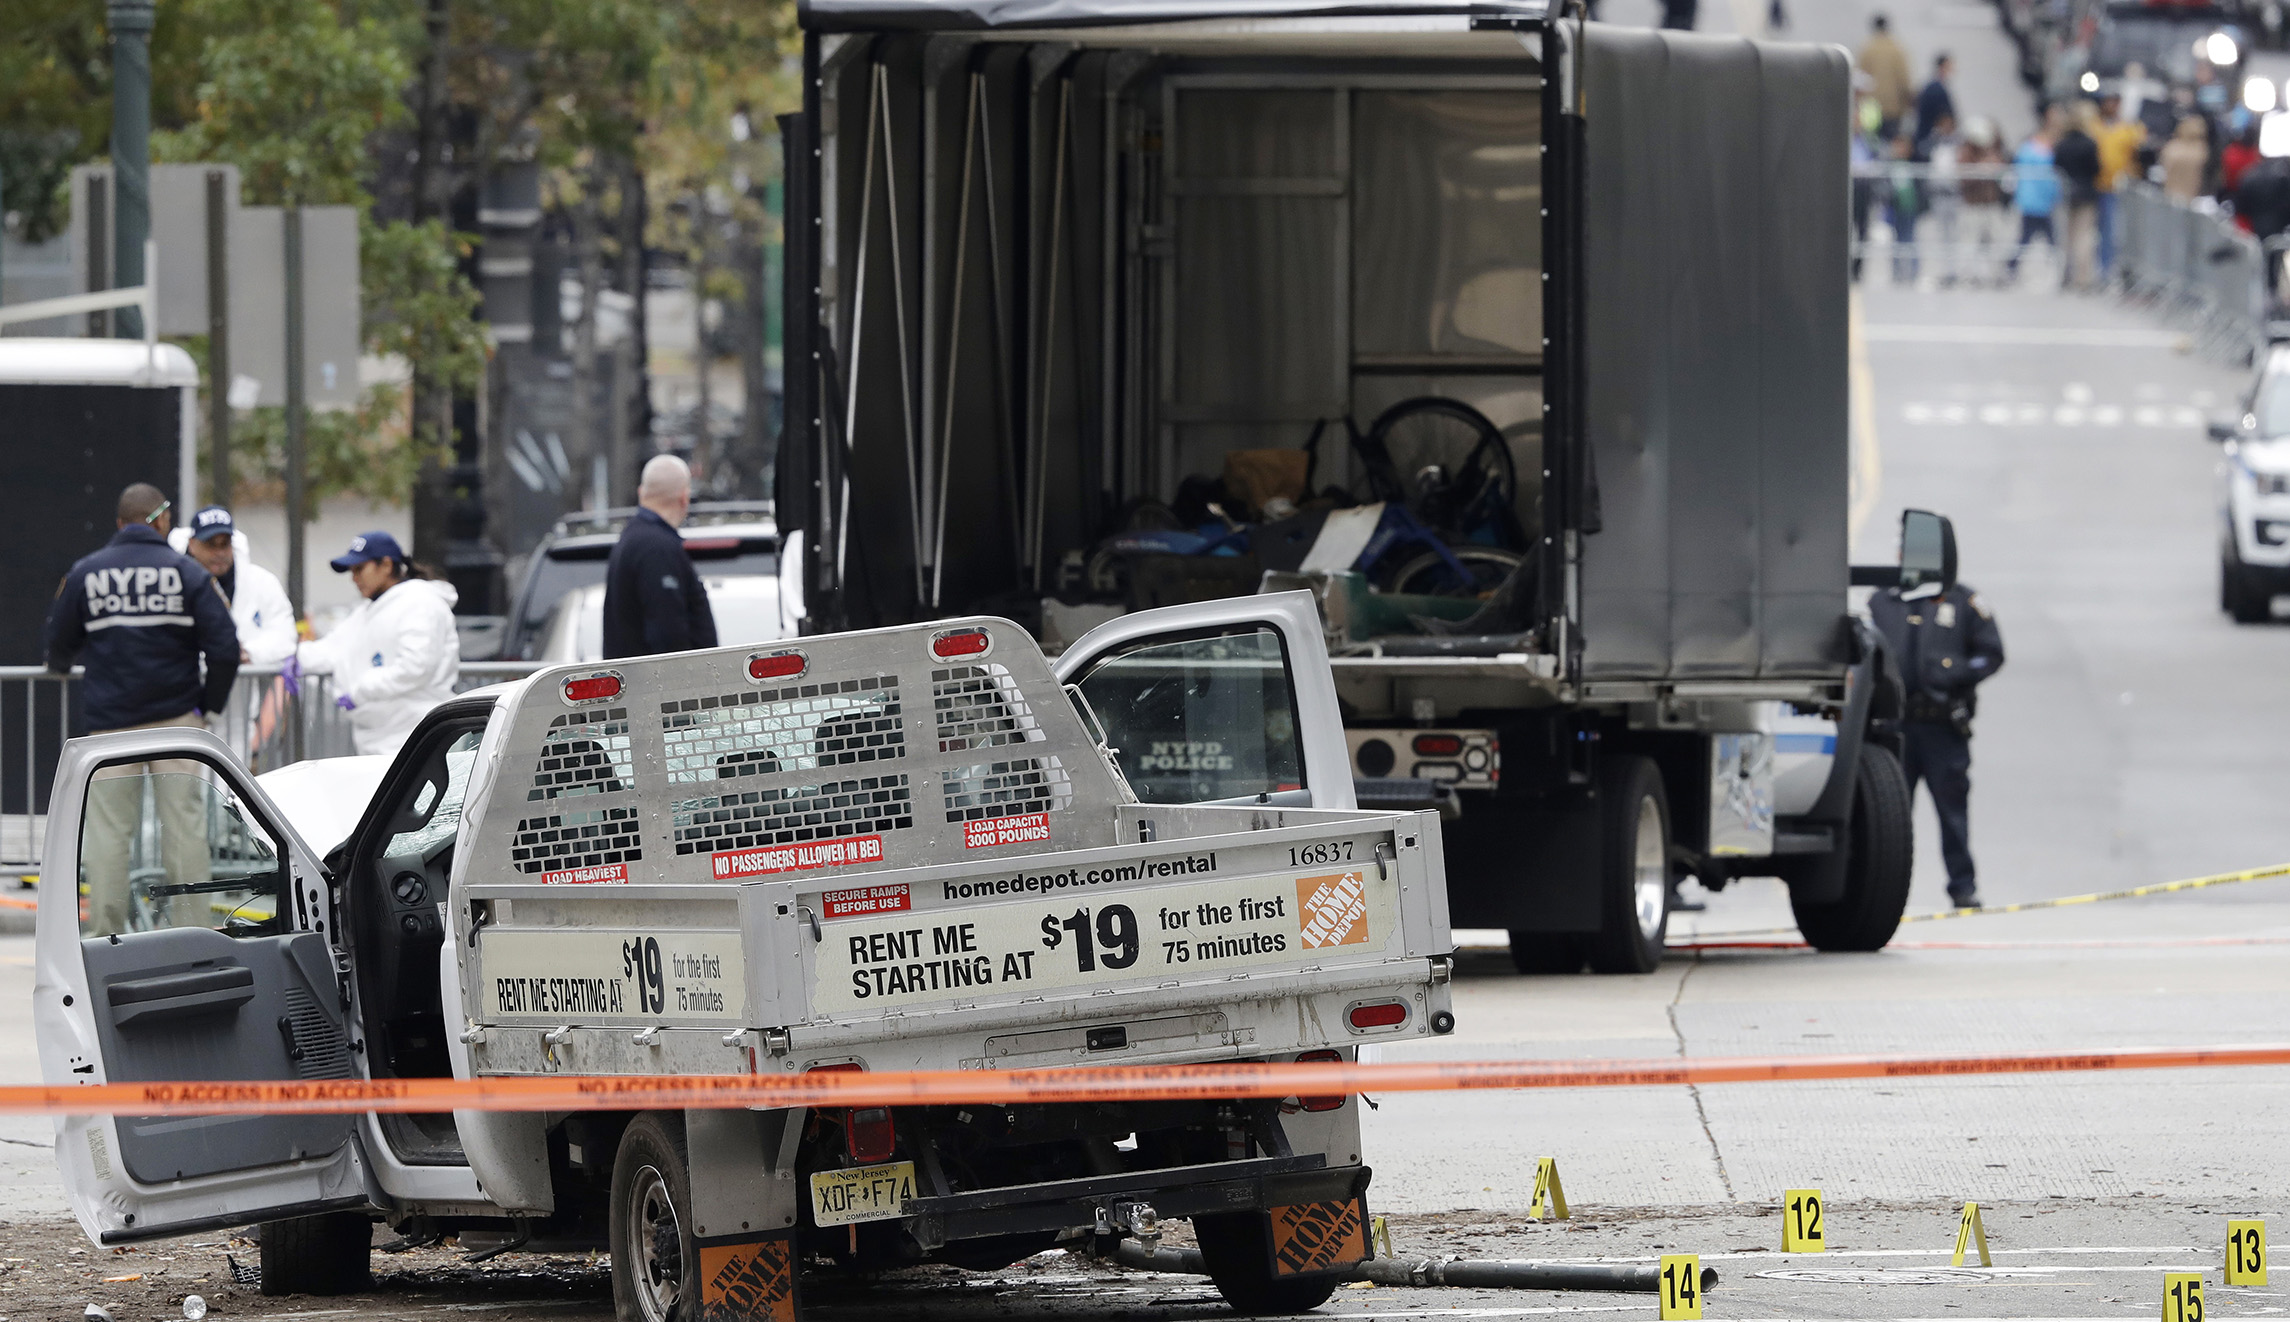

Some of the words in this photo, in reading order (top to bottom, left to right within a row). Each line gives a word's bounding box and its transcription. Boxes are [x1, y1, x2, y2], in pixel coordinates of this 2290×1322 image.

[84, 567, 183, 599] NYPD
[88, 594, 184, 616] POLICE
[1140, 755, 1233, 771] POLICE
[1151, 741, 1222, 756] NYPD
[967, 832, 997, 848] 3000
[998, 825, 1049, 843] POUNDS
[969, 819, 995, 833] LOAD
[996, 814, 1044, 829] CAPACITY
[714, 857, 730, 875] NO
[732, 850, 796, 873] PASSENGERS
[798, 843, 845, 866] ALLOWED
[847, 842, 858, 860] IN
[859, 839, 881, 857] BED
[1288, 841, 1354, 867] 16837
[546, 872, 573, 884] LOAD
[574, 866, 622, 882] HEAVIEST
[943, 852, 1218, 900] homedepot.com/rental
[824, 889, 868, 902] SECURE
[870, 885, 908, 898] RAMPS
[833, 900, 878, 913] BEFORE
[880, 897, 901, 909] USE
[1304, 882, 1332, 913] THE
[1159, 907, 1190, 931] for
[1197, 902, 1232, 926] the
[1238, 895, 1285, 921] first
[1300, 872, 1364, 948] HOME
[1327, 897, 1366, 946] DEPOT
[849, 928, 923, 965] RENT
[932, 923, 977, 956] ME
[1040, 903, 1140, 973] $19
[1162, 939, 1190, 964] 75
[1197, 931, 1286, 961] minutes
[622, 936, 665, 1015] $19
[673, 953, 687, 979] for
[687, 954, 701, 979] the
[702, 954, 721, 979] first
[852, 955, 993, 999] STARTING
[1002, 950, 1035, 983] AT
[496, 977, 528, 1012] RENT
[530, 978, 549, 1012] ME
[550, 978, 608, 1013] STARTING
[610, 978, 624, 1013] AT
[675, 987, 688, 1012] 75
[689, 987, 724, 1012] minutes
[143, 1084, 174, 1102] NO
[181, 1084, 261, 1102] ACCESS
[279, 1084, 309, 1101] NO
[315, 1082, 397, 1100] ACCESS
[577, 1079, 607, 1095] NO
[614, 1077, 694, 1094] ACCESS
[836, 1172, 860, 1181] New
[861, 1168, 890, 1180] Jersey
[818, 1182, 857, 1213] XDF
[872, 1176, 912, 1207] F74
[846, 1209, 890, 1221] COMMERCIAL
[1790, 1196, 1822, 1241] 12
[1312, 1208, 1361, 1268] DEPOT
[2230, 1228, 2261, 1273] 13
[1663, 1263, 1695, 1309] 14
[2171, 1280, 2202, 1322] 15
